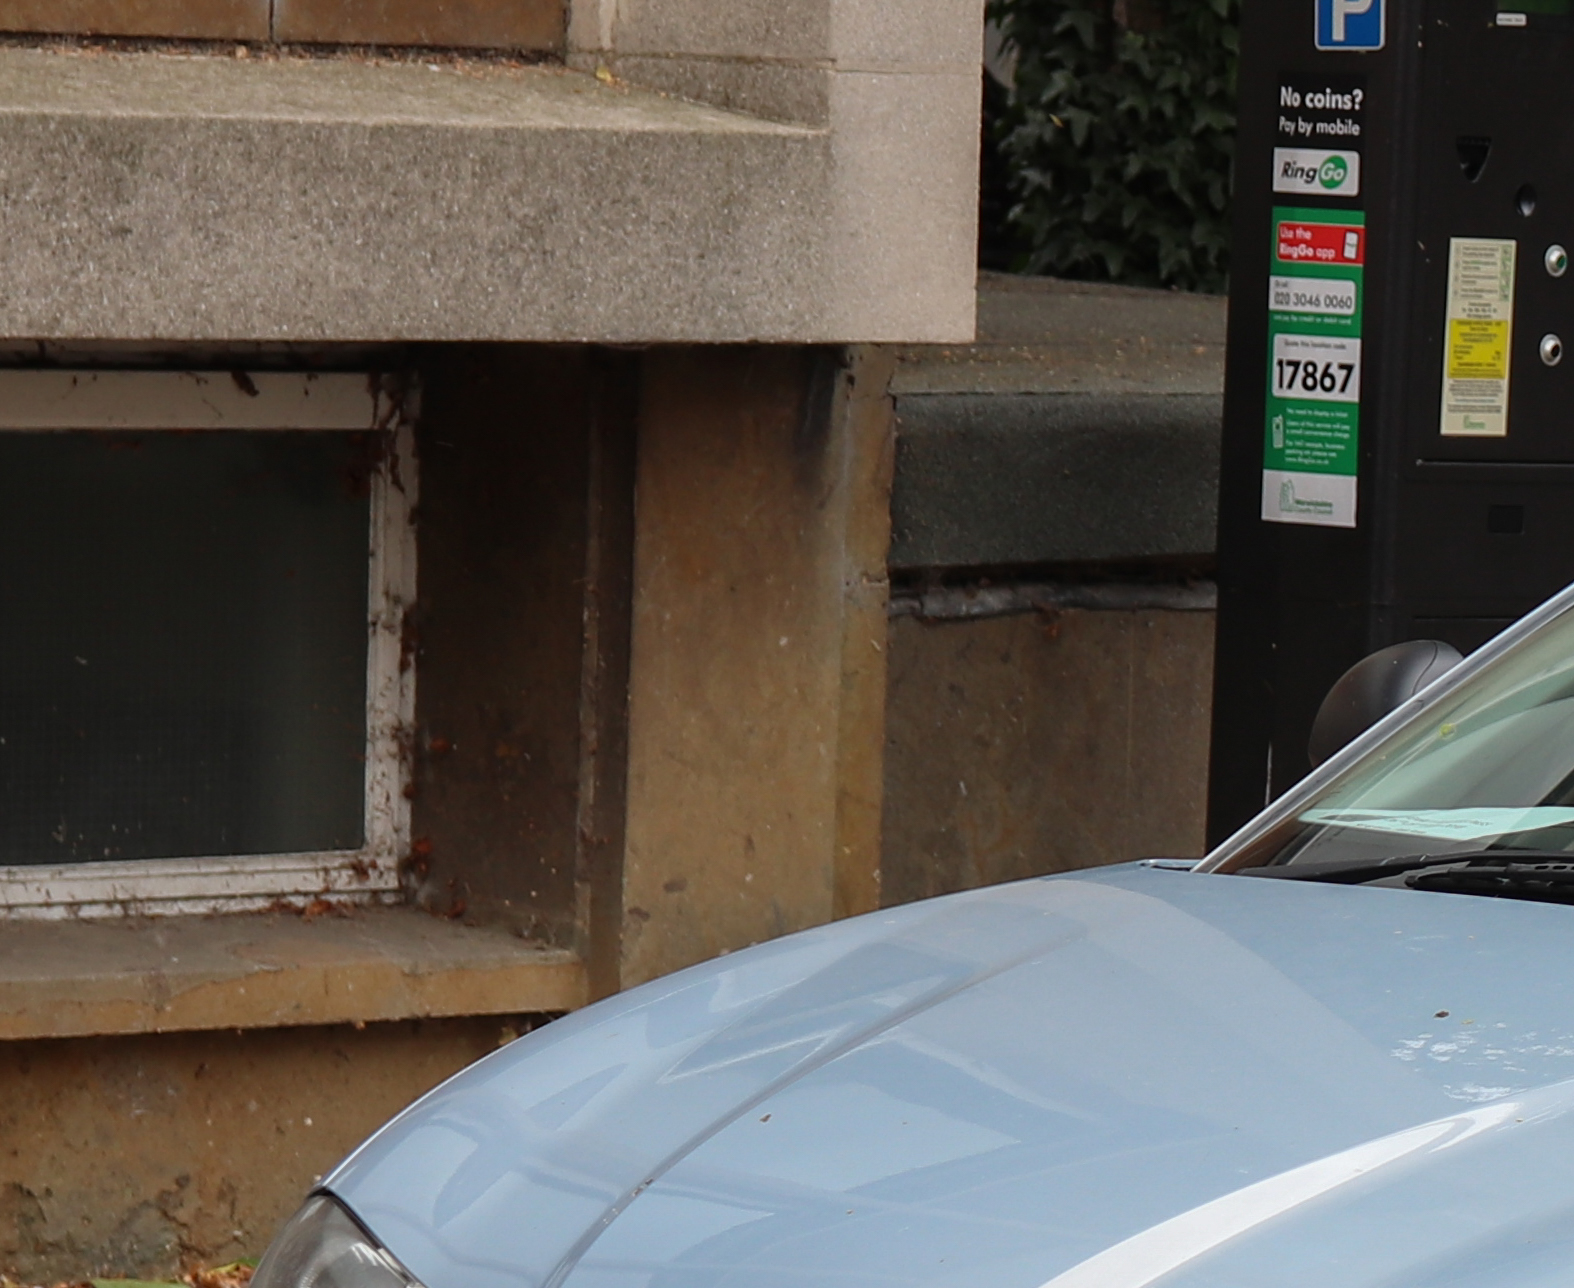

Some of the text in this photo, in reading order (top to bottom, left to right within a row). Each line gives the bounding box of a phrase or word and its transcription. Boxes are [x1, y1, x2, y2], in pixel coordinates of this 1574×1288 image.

[1280, 86, 1364, 111] No coins?
[1279, 115, 1360, 137] Pay by mobile
[1296, 227, 1312, 240] the
[1279, 242, 1336, 260] RingGo app
[1274, 292, 1353, 309] 020 3046 0060
[1276, 358, 1355, 393] 17867
